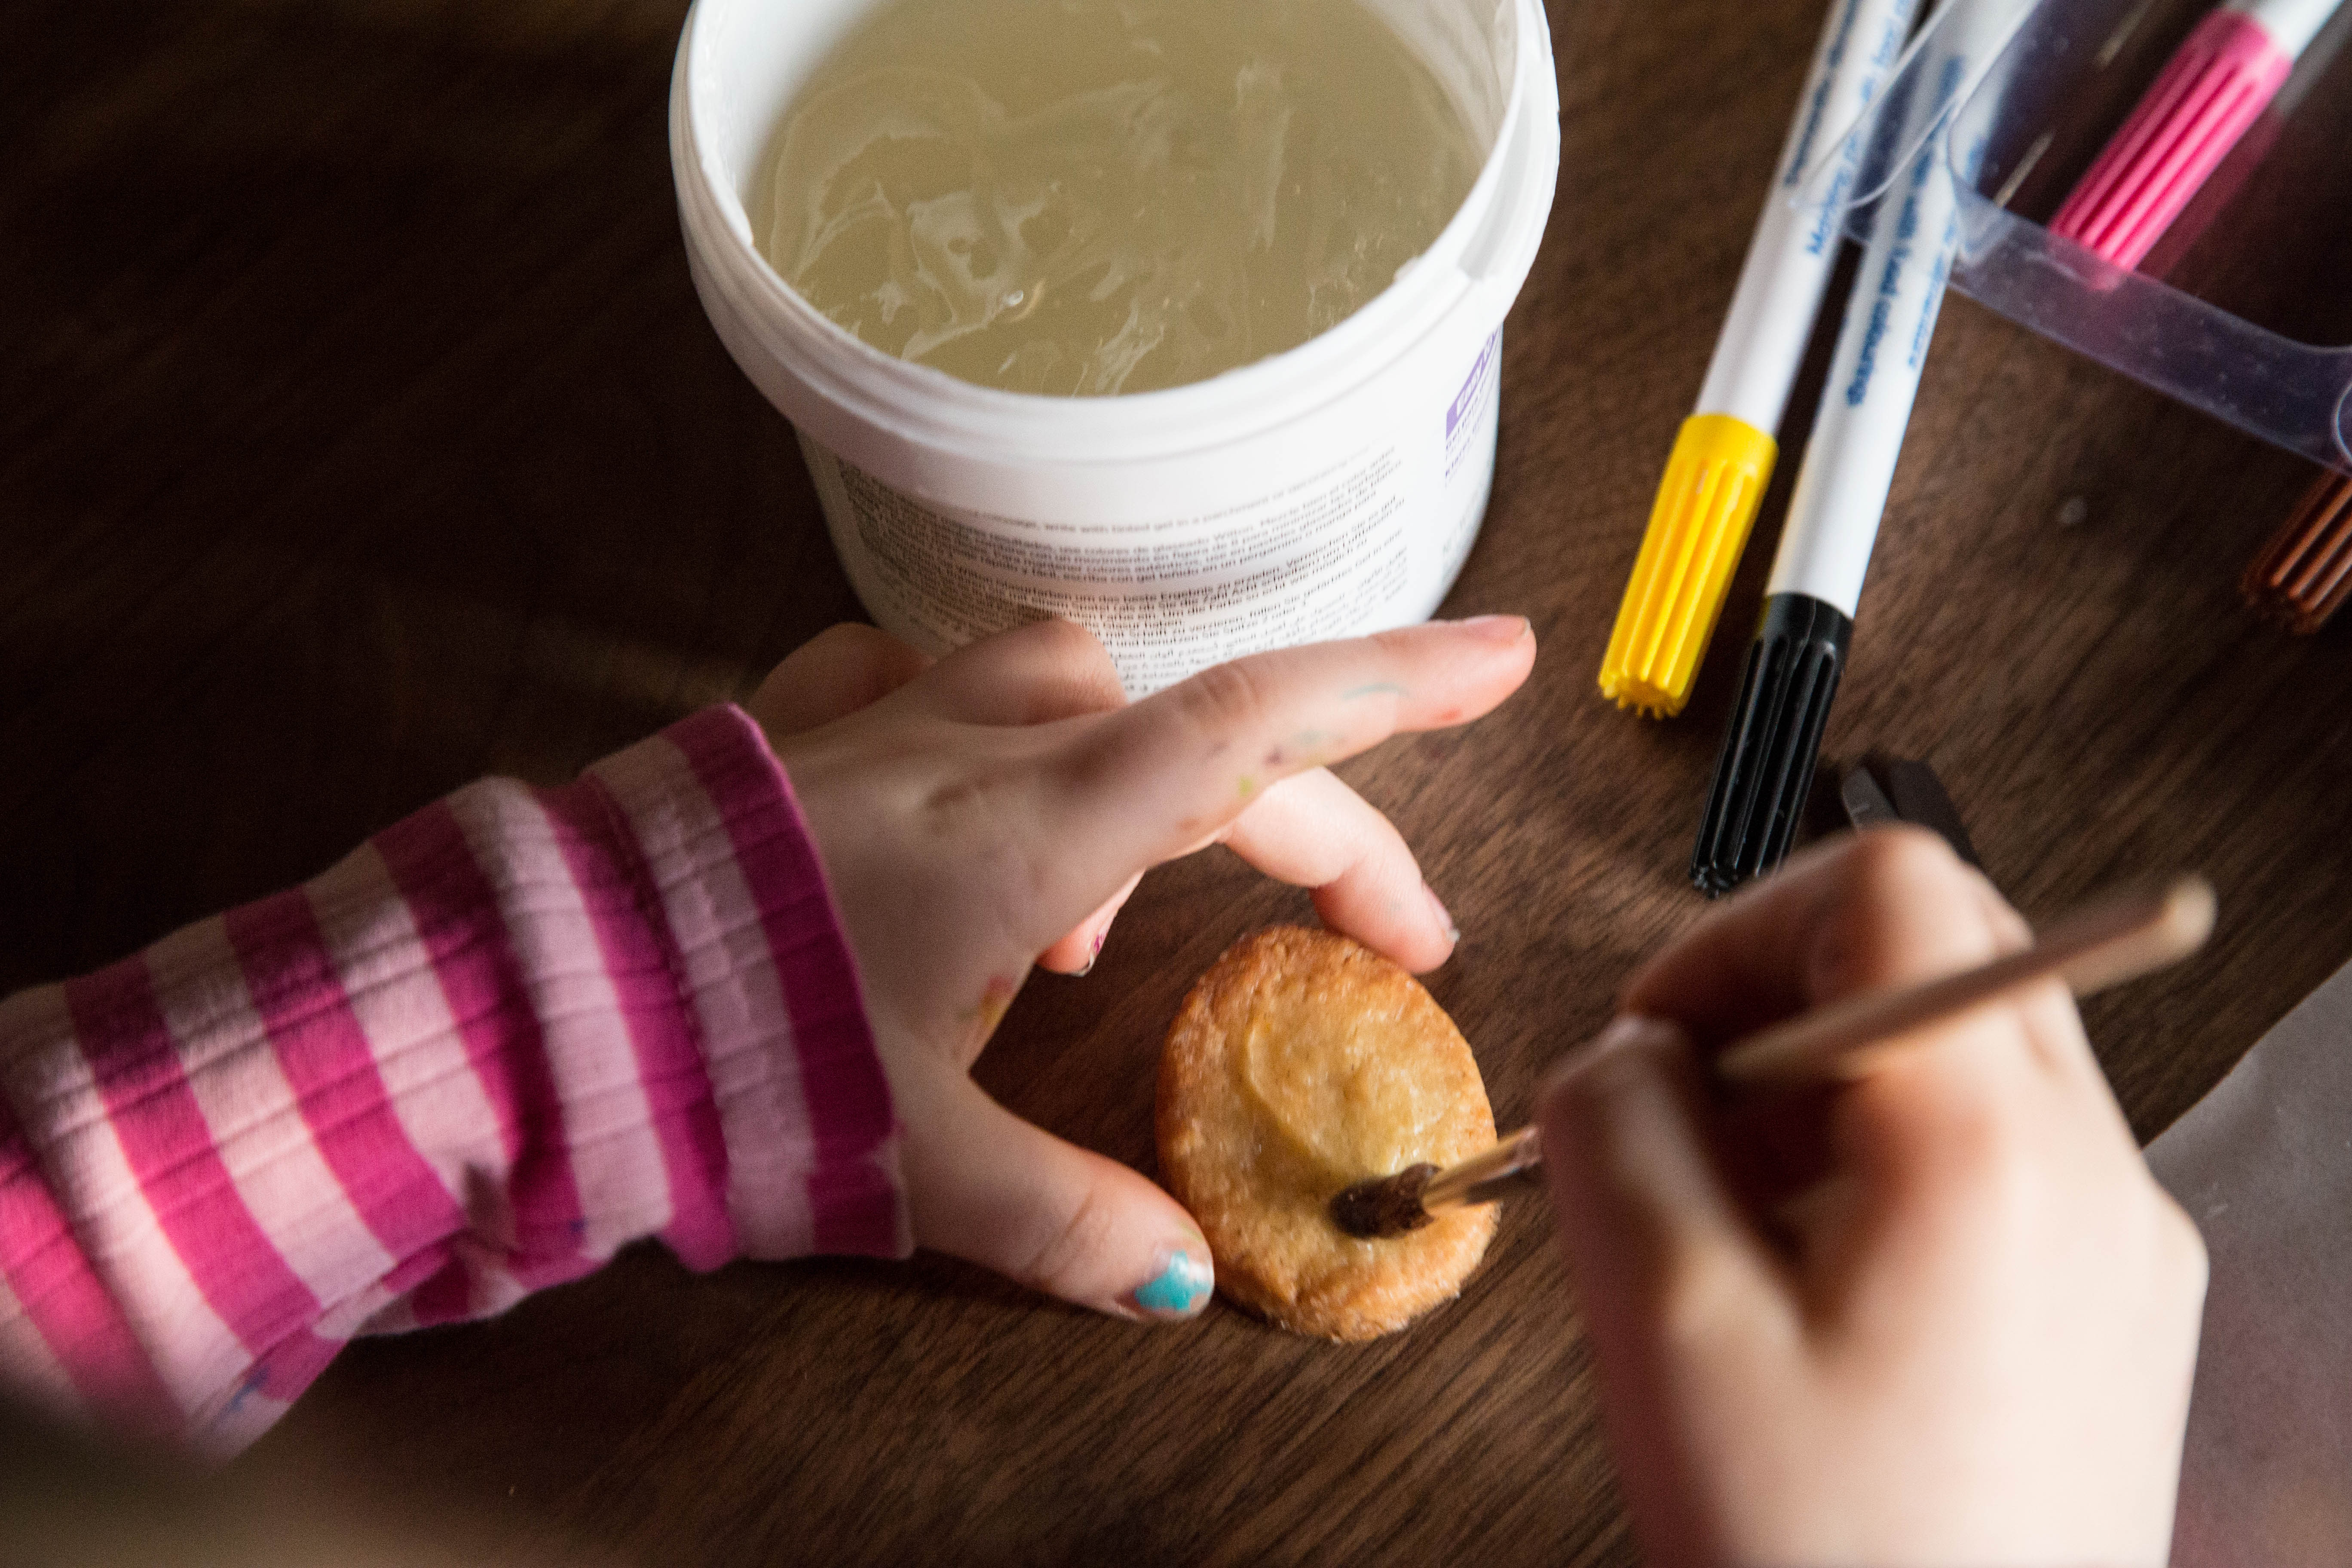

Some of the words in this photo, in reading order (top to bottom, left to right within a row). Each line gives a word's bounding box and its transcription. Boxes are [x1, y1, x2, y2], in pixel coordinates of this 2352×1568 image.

[1153, 534, 1209, 553] glaseado
[1303, 490, 1326, 509] bien
[1202, 494, 1268, 523] parchment
[1136, 572, 1155, 583] gel
[1240, 532, 1302, 565] pergamino
[1315, 507, 1351, 535] manga
[1173, 545, 1208, 560] figura
[1243, 529, 1268, 545] para
[1249, 525, 1295, 553] pasteles
[1123, 592, 1156, 602] beste
[1161, 583, 1213, 601] Ergebnis
[1286, 528, 1348, 568] Vermischen
